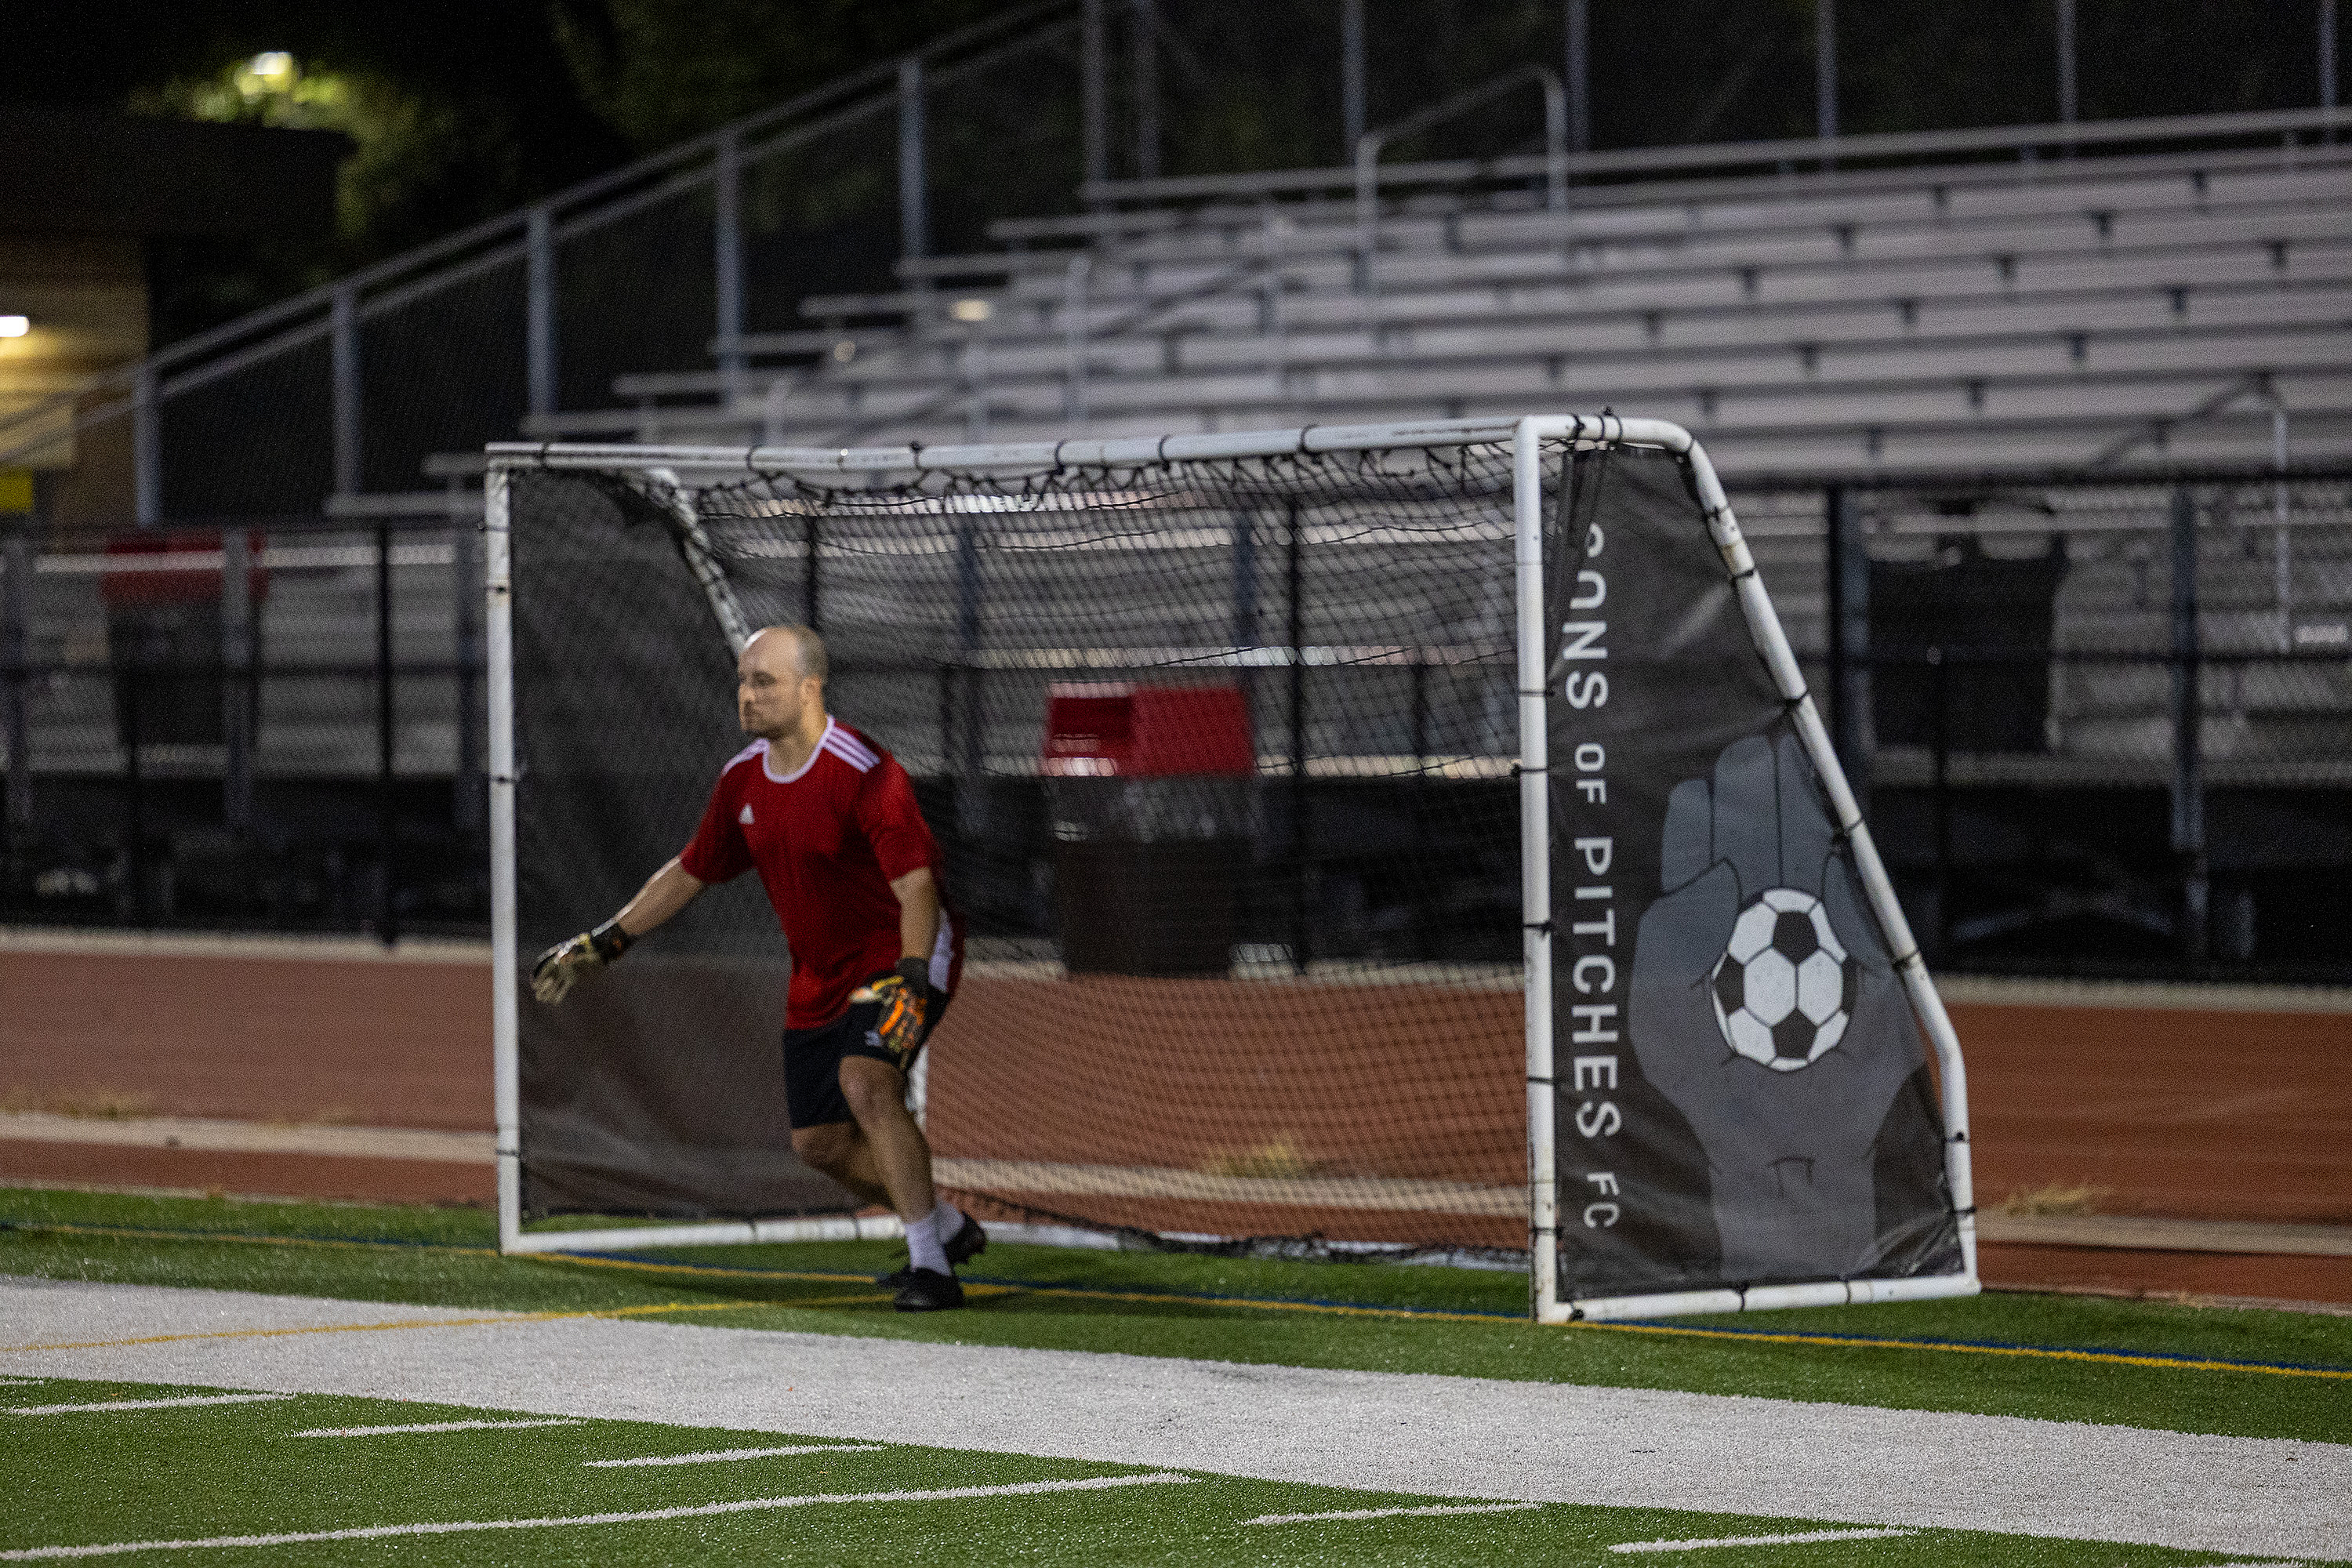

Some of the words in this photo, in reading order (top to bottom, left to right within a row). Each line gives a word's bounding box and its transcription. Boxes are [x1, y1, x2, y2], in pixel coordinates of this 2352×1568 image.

[1573, 743, 1606, 804] OF
[1572, 837, 1621, 1138] PITCHES
[1583, 1171, 1620, 1229] FC
